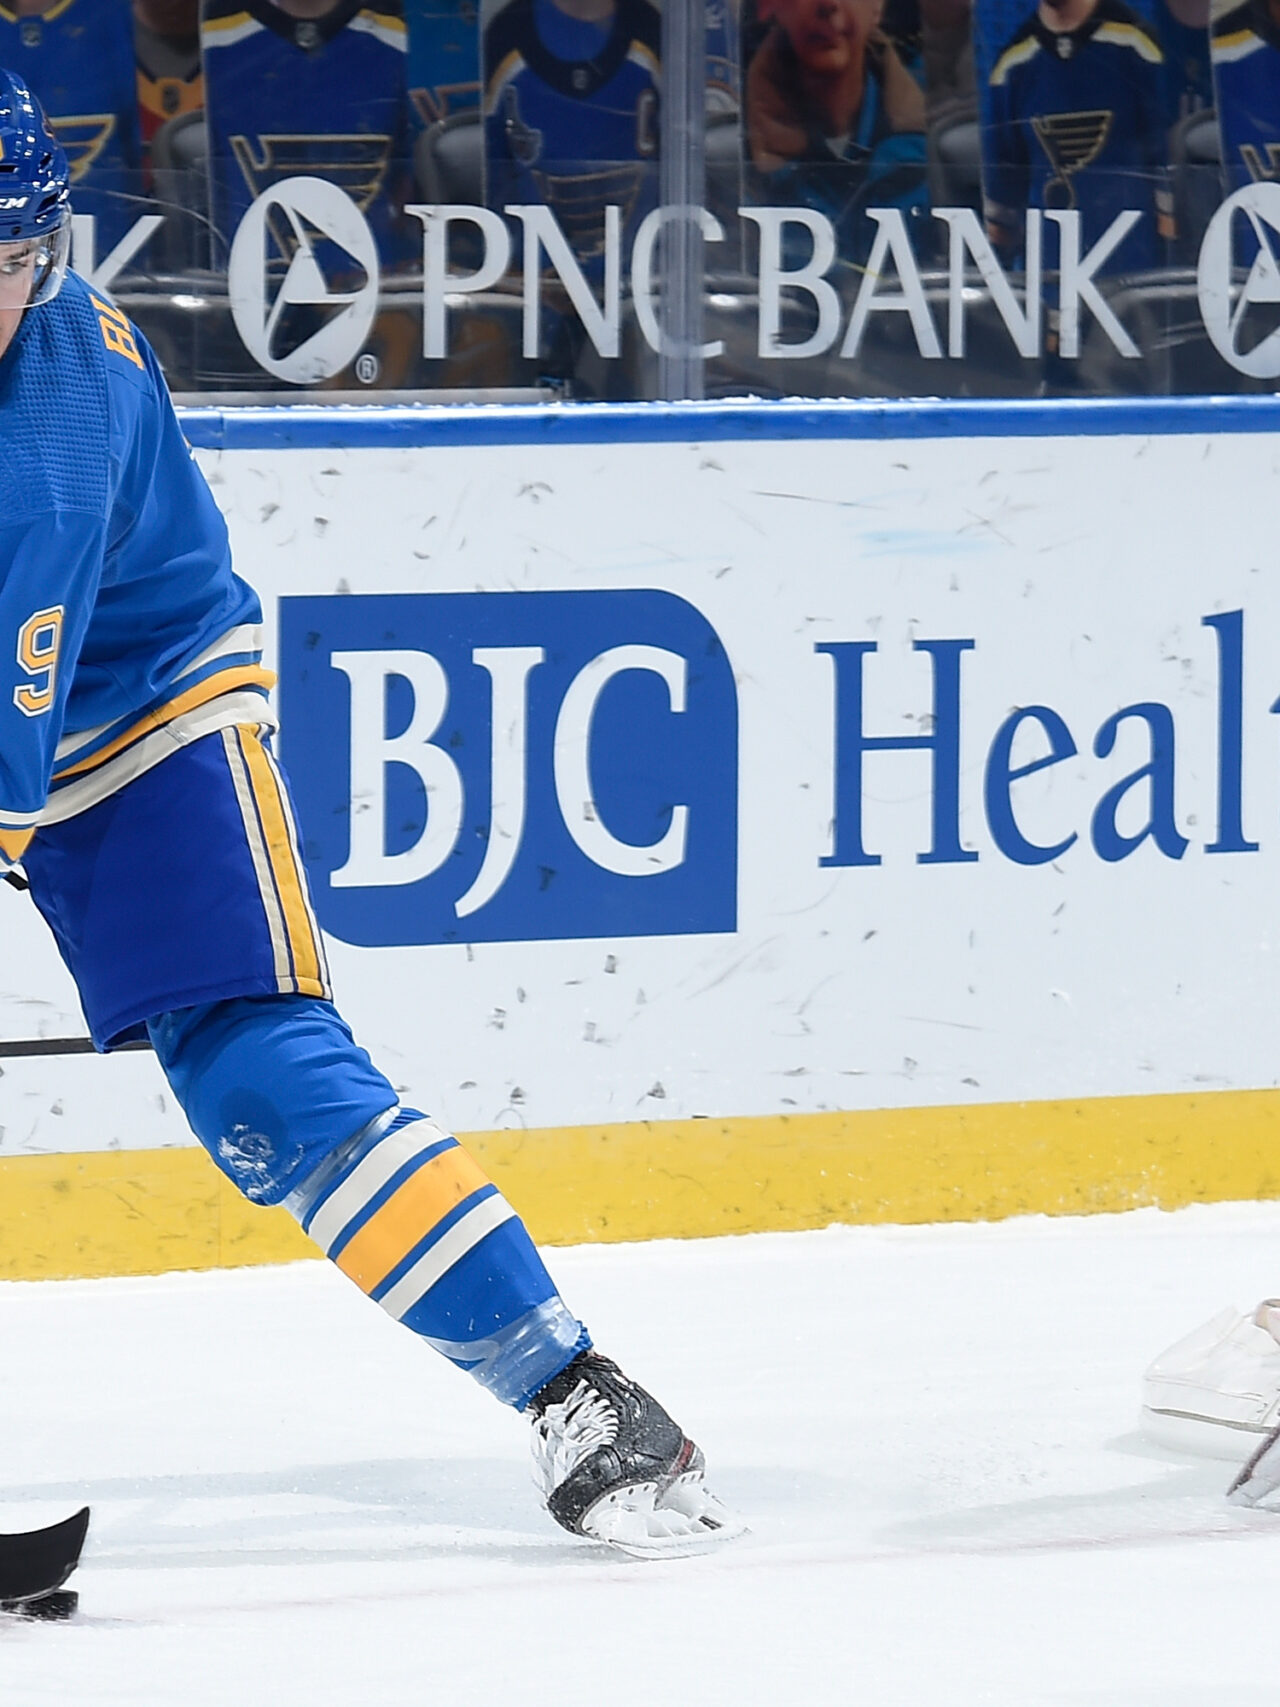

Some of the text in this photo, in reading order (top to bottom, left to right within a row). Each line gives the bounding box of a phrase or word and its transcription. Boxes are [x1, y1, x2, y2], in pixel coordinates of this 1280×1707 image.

[405, 204, 1144, 360] PNC BANK
[12, 604, 65, 718] 9
[330, 607, 1280, 918] BJC Heal
